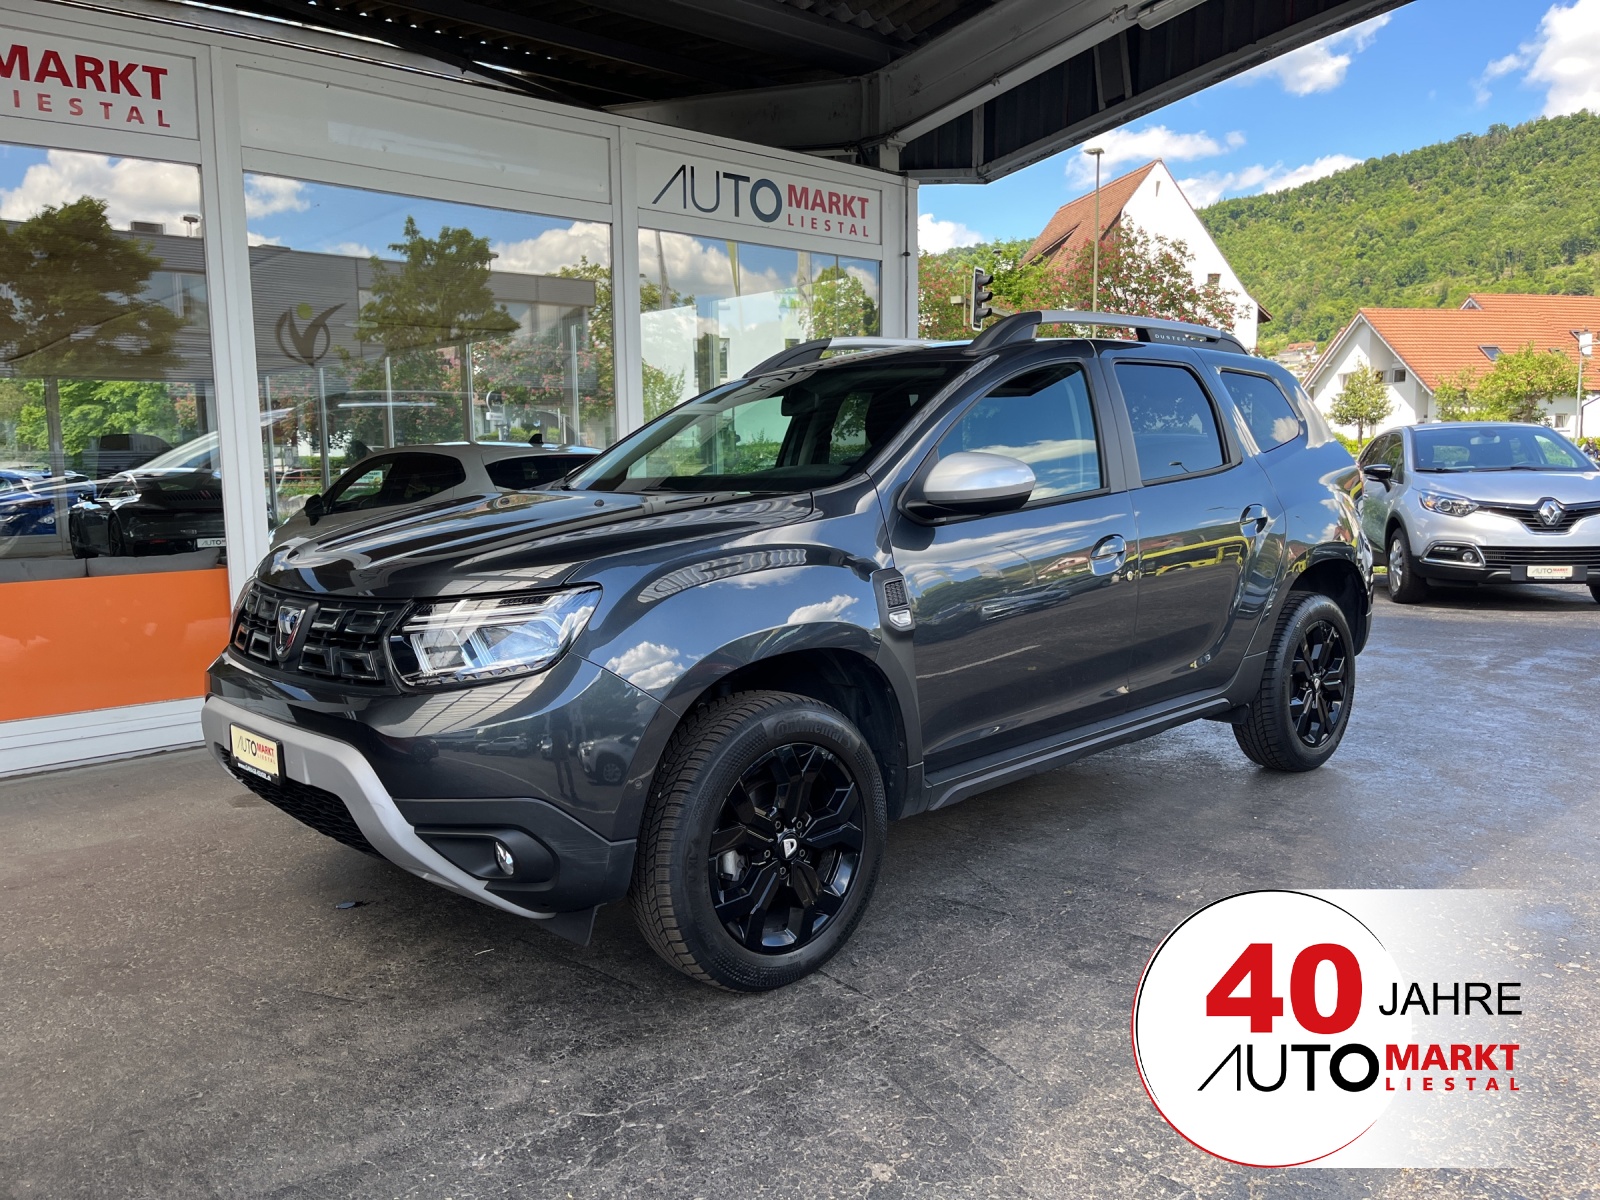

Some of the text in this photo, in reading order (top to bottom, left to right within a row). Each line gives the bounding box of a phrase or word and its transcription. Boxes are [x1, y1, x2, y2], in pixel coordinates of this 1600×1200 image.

[0, 44, 168, 100] MARKT
[652, 164, 869, 223] AUTO MARKT
[787, 213, 869, 238] LIESTAL
[1154, 333, 1187, 342] DUSTER
[237, 735, 275, 758] AUTO MARKT
